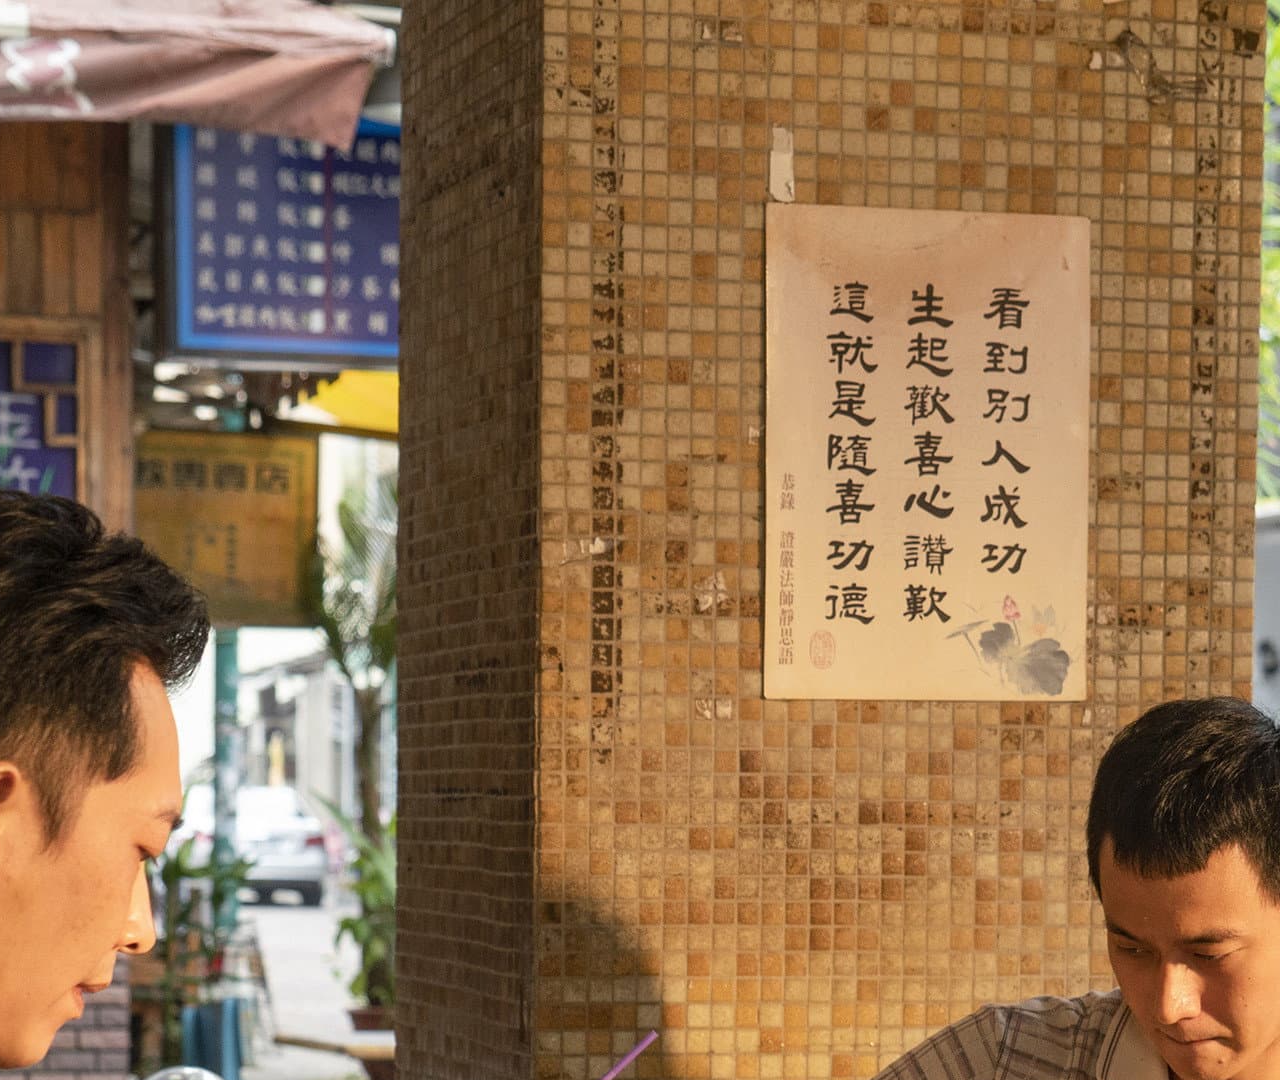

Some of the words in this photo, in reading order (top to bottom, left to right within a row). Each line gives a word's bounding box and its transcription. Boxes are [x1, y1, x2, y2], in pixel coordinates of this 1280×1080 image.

[825, 281, 878, 625] 這就是隨喜功德
[903, 283, 954, 623] 生起歡喜心讚歎
[981, 287, 1030, 575] 看到別人成功
